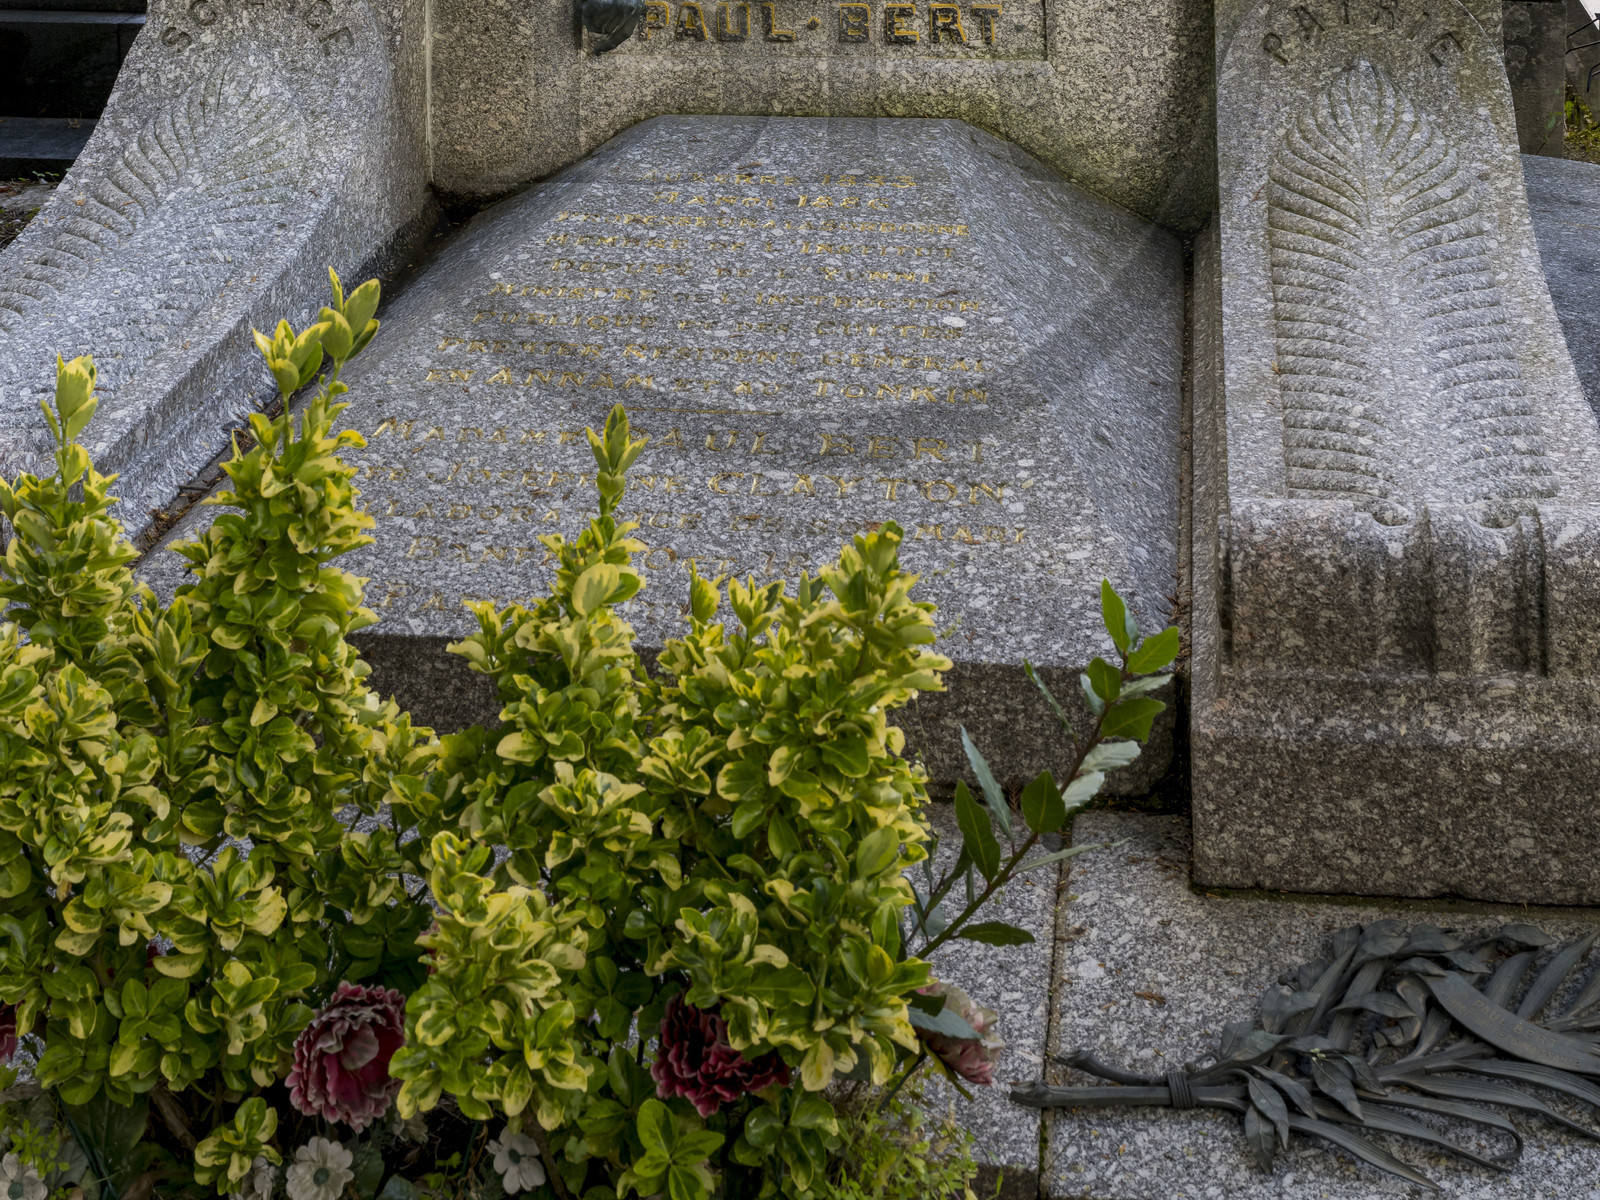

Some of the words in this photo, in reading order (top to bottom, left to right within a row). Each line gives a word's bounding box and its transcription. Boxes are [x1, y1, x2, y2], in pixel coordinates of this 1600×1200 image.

[638, 2, 796, 43] PAUL
[839, 3, 1002, 44] BERT
[638, 169, 799, 186] AUXERRE
[822, 173, 917, 188] 1833
[797, 195, 891, 210] 1886
[819, 218, 970, 237] SORBONNE
[544, 232, 689, 250] MEMBRE
[716, 266, 752, 278] DE
[487, 282, 659, 302] MINISTRE
[470, 309, 659, 333] PUBLIQUE
[815, 320, 963, 340] CULTES
[437, 336, 604, 358] PREMIER
[424, 368, 478, 384] EN
[484, 365, 657, 391] ANNAM
[672, 377, 721, 394] ET
[732, 380, 786, 397] AU
[810, 378, 992, 404] TONKIN
[371, 416, 584, 445] MADAME
[818, 432, 996, 464] BERT
[706, 471, 1010, 505] CLAYTON
[913, 523, 1027, 545] MARI
[1513, 1021, 1561, 1049] BERT
